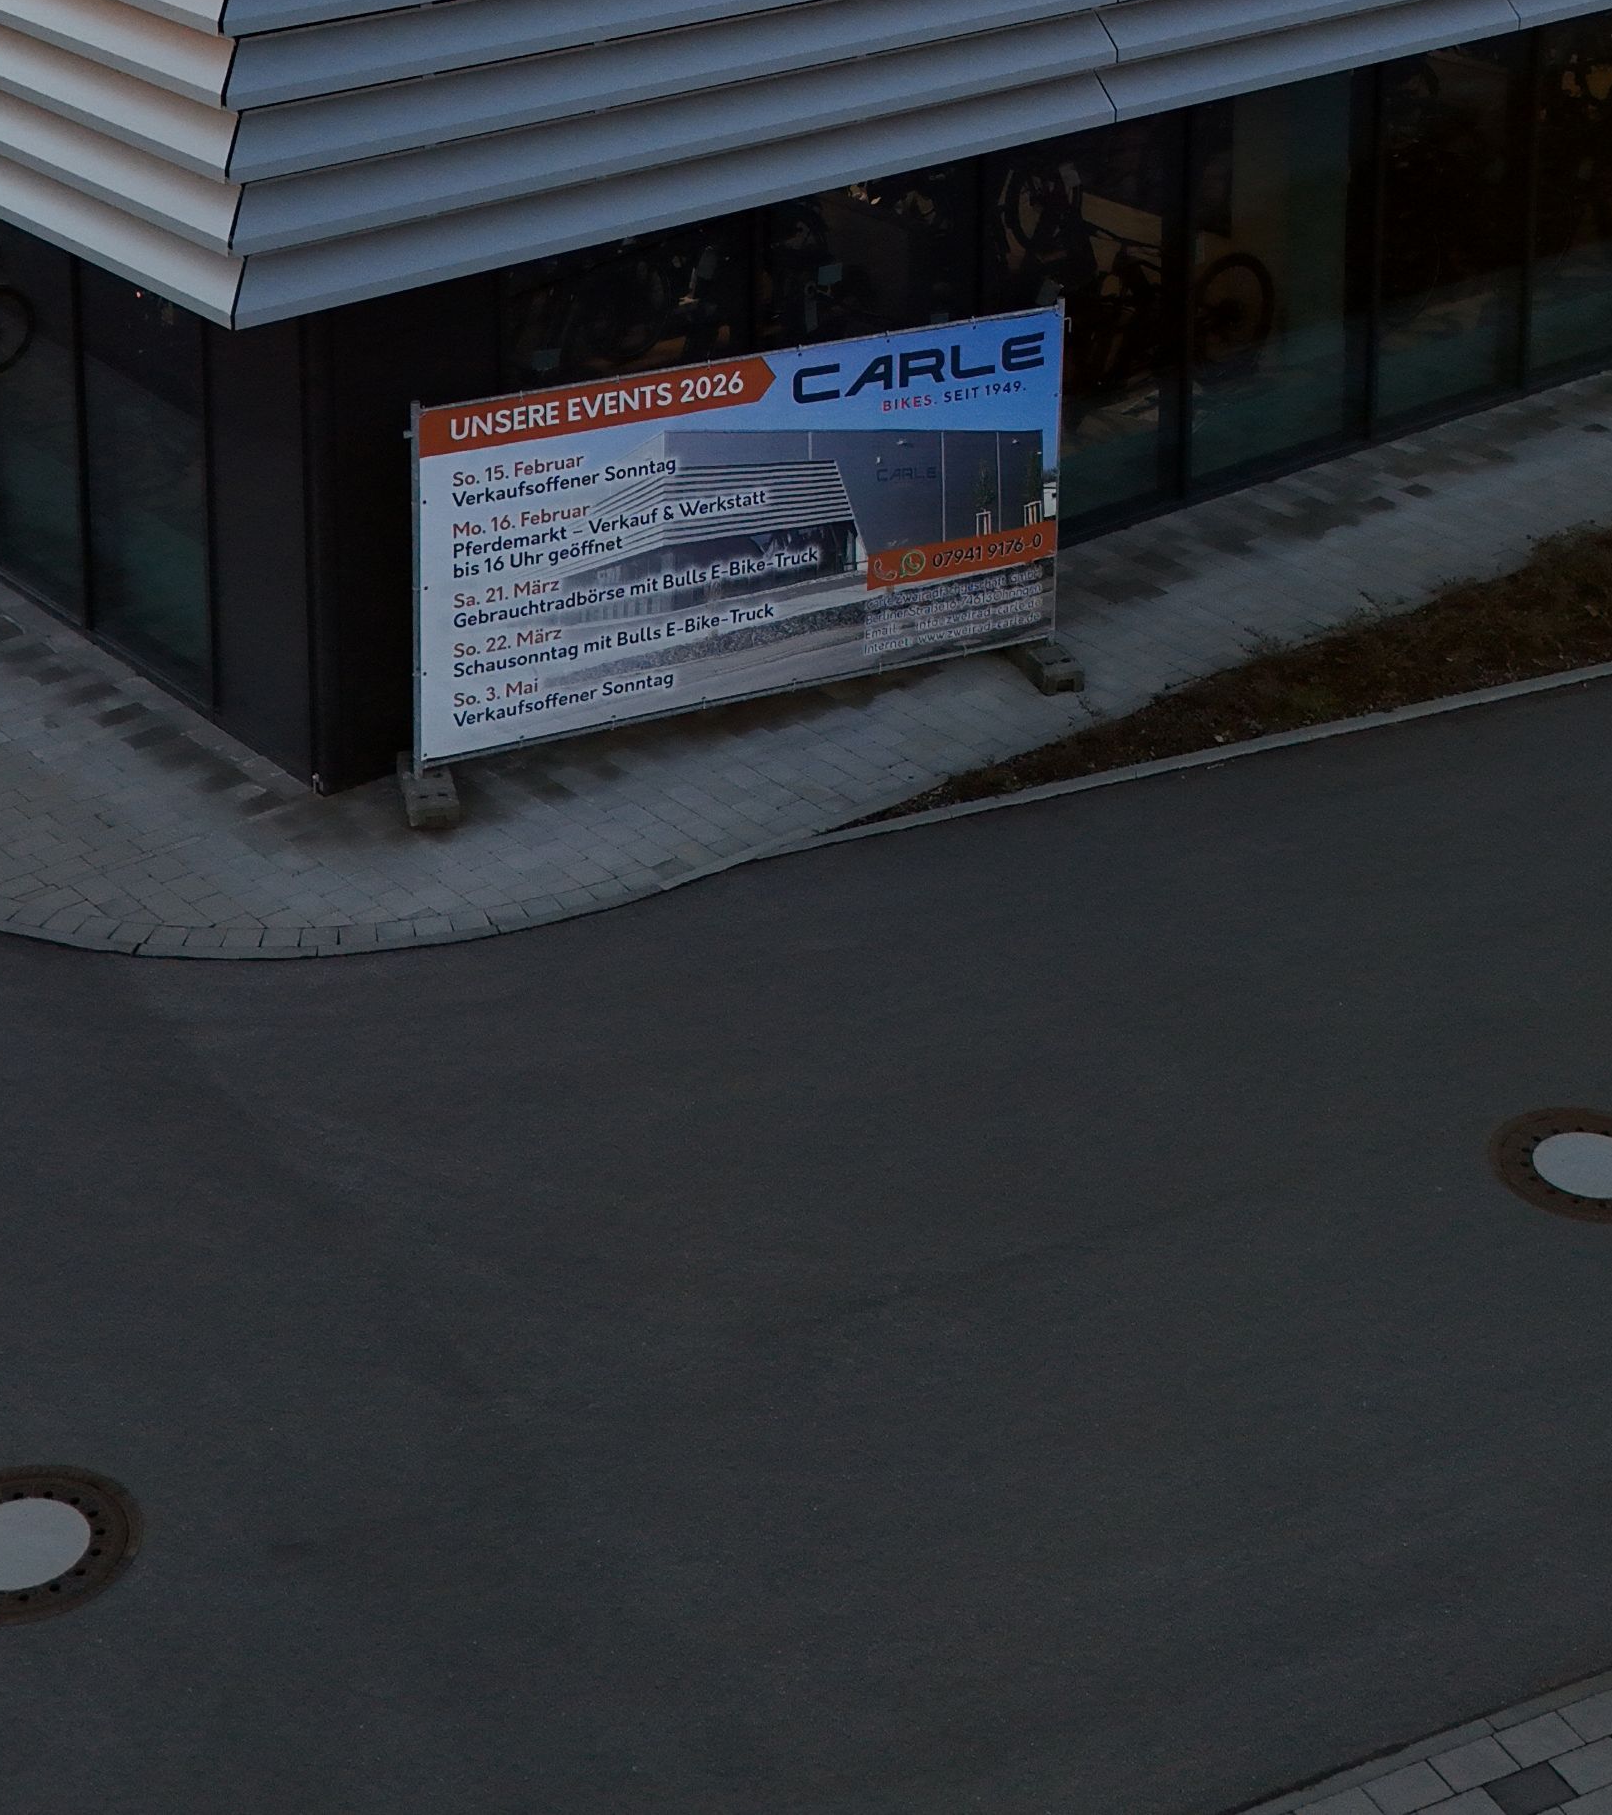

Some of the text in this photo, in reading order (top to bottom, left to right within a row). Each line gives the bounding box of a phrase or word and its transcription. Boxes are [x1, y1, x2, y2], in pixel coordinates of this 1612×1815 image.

[793, 331, 1045, 404] CARLE
[450, 371, 744, 440] UNSERE EVENTS 2026
[883, 380, 1027, 412] BIKES. SEIT 1949.
[452, 454, 585, 487] So. 15. Februar
[452, 458, 677, 507] Verkaufsoffener Sonntag
[453, 505, 591, 538] Mo. 16. Februar
[453, 526, 567, 558] Pferdemarkt
[589, 508, 658, 534] Verkauf
[663, 505, 674, 520] &
[679, 490, 766, 517] Werkstatt
[453, 536, 623, 578] bis 16 Uhr geöffnet
[933, 532, 1042, 569] 07941 9176-0
[453, 547, 818, 628] Gebrauchtradbörse mit Bulls E-Bike-Truck
[453, 580, 559, 608] Sa. 21. März
[453, 603, 774, 678] Schausonntag mit Bulls E-Bike-Truck
[453, 628, 562, 658] So. 22. März
[453, 678, 539, 707] So. 3. Mai
[453, 673, 674, 727] Verkaufsoffener Sonntag
